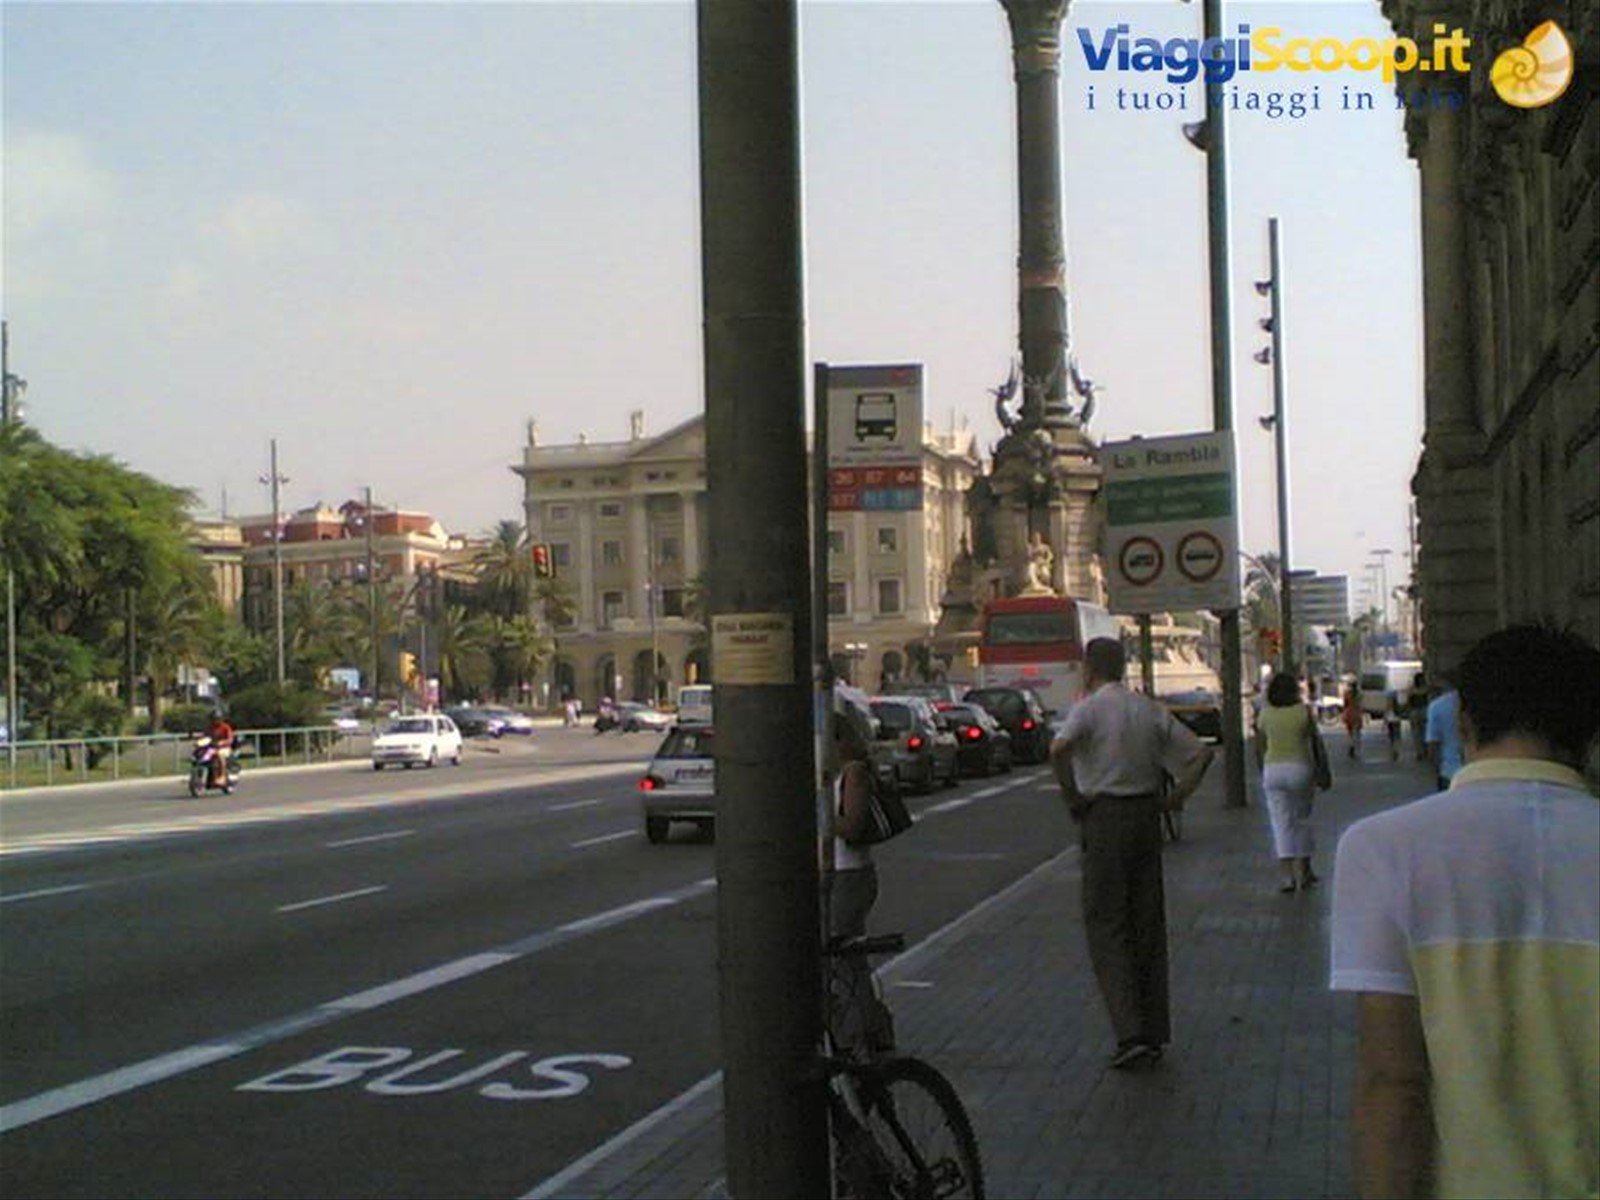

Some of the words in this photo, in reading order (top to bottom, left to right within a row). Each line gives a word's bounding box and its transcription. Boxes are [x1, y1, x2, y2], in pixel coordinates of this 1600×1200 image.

[1113, 453, 1136, 469] La
[1145, 445, 1221, 465] Rambla
[233, 1046, 632, 1100] BUS
